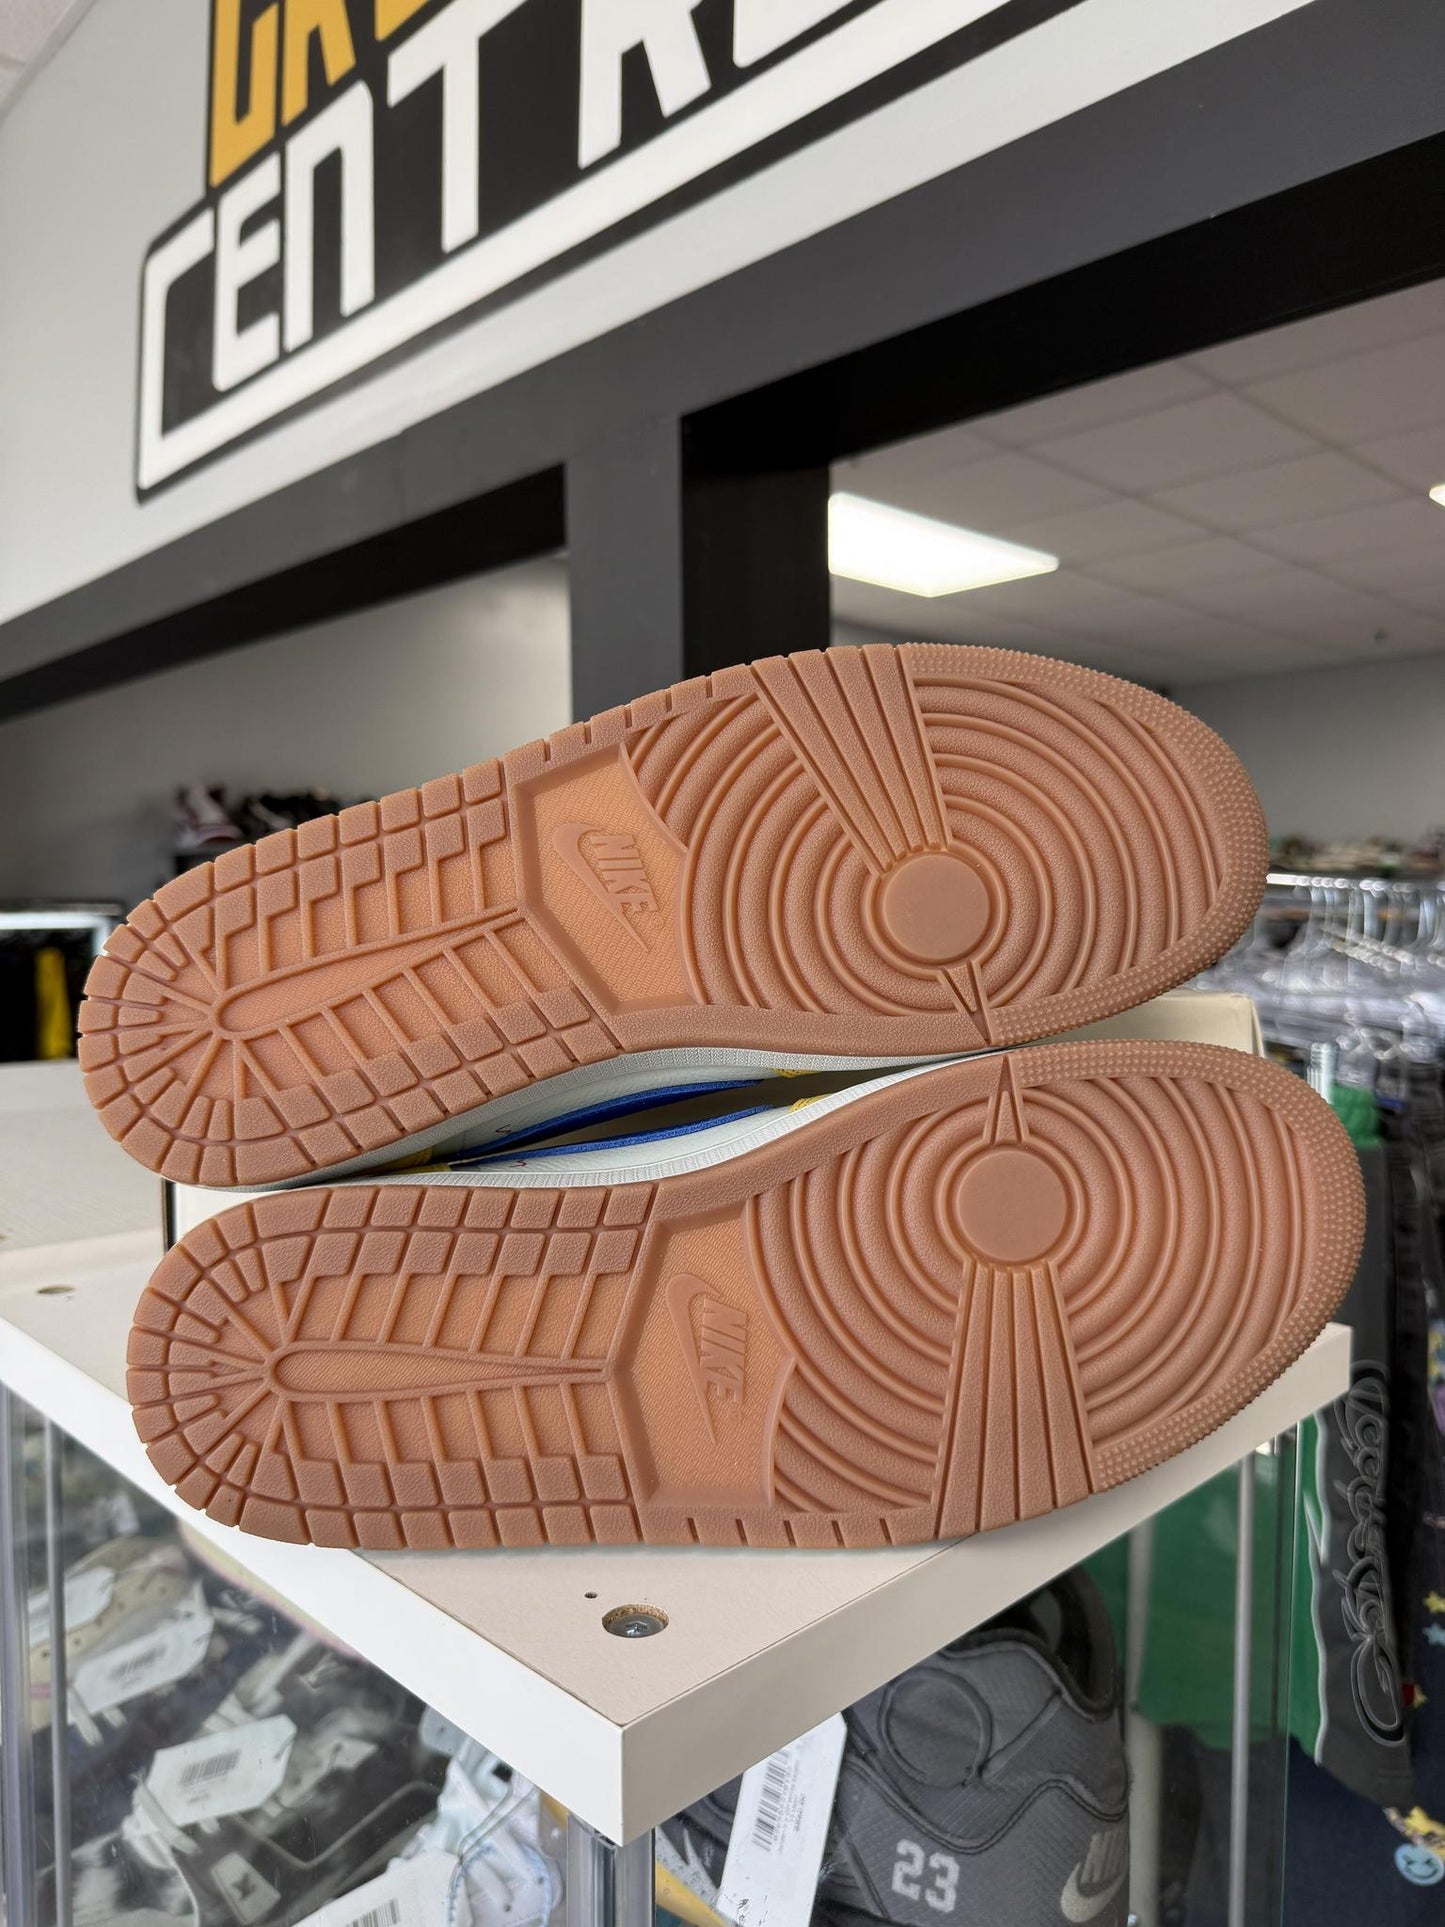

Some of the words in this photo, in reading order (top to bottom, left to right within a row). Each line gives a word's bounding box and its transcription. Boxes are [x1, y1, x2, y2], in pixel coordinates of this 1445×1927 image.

[590, 833, 661, 915] NIKE
[700, 1297, 748, 1402] NIKE
[892, 1839, 960, 1913] 23
